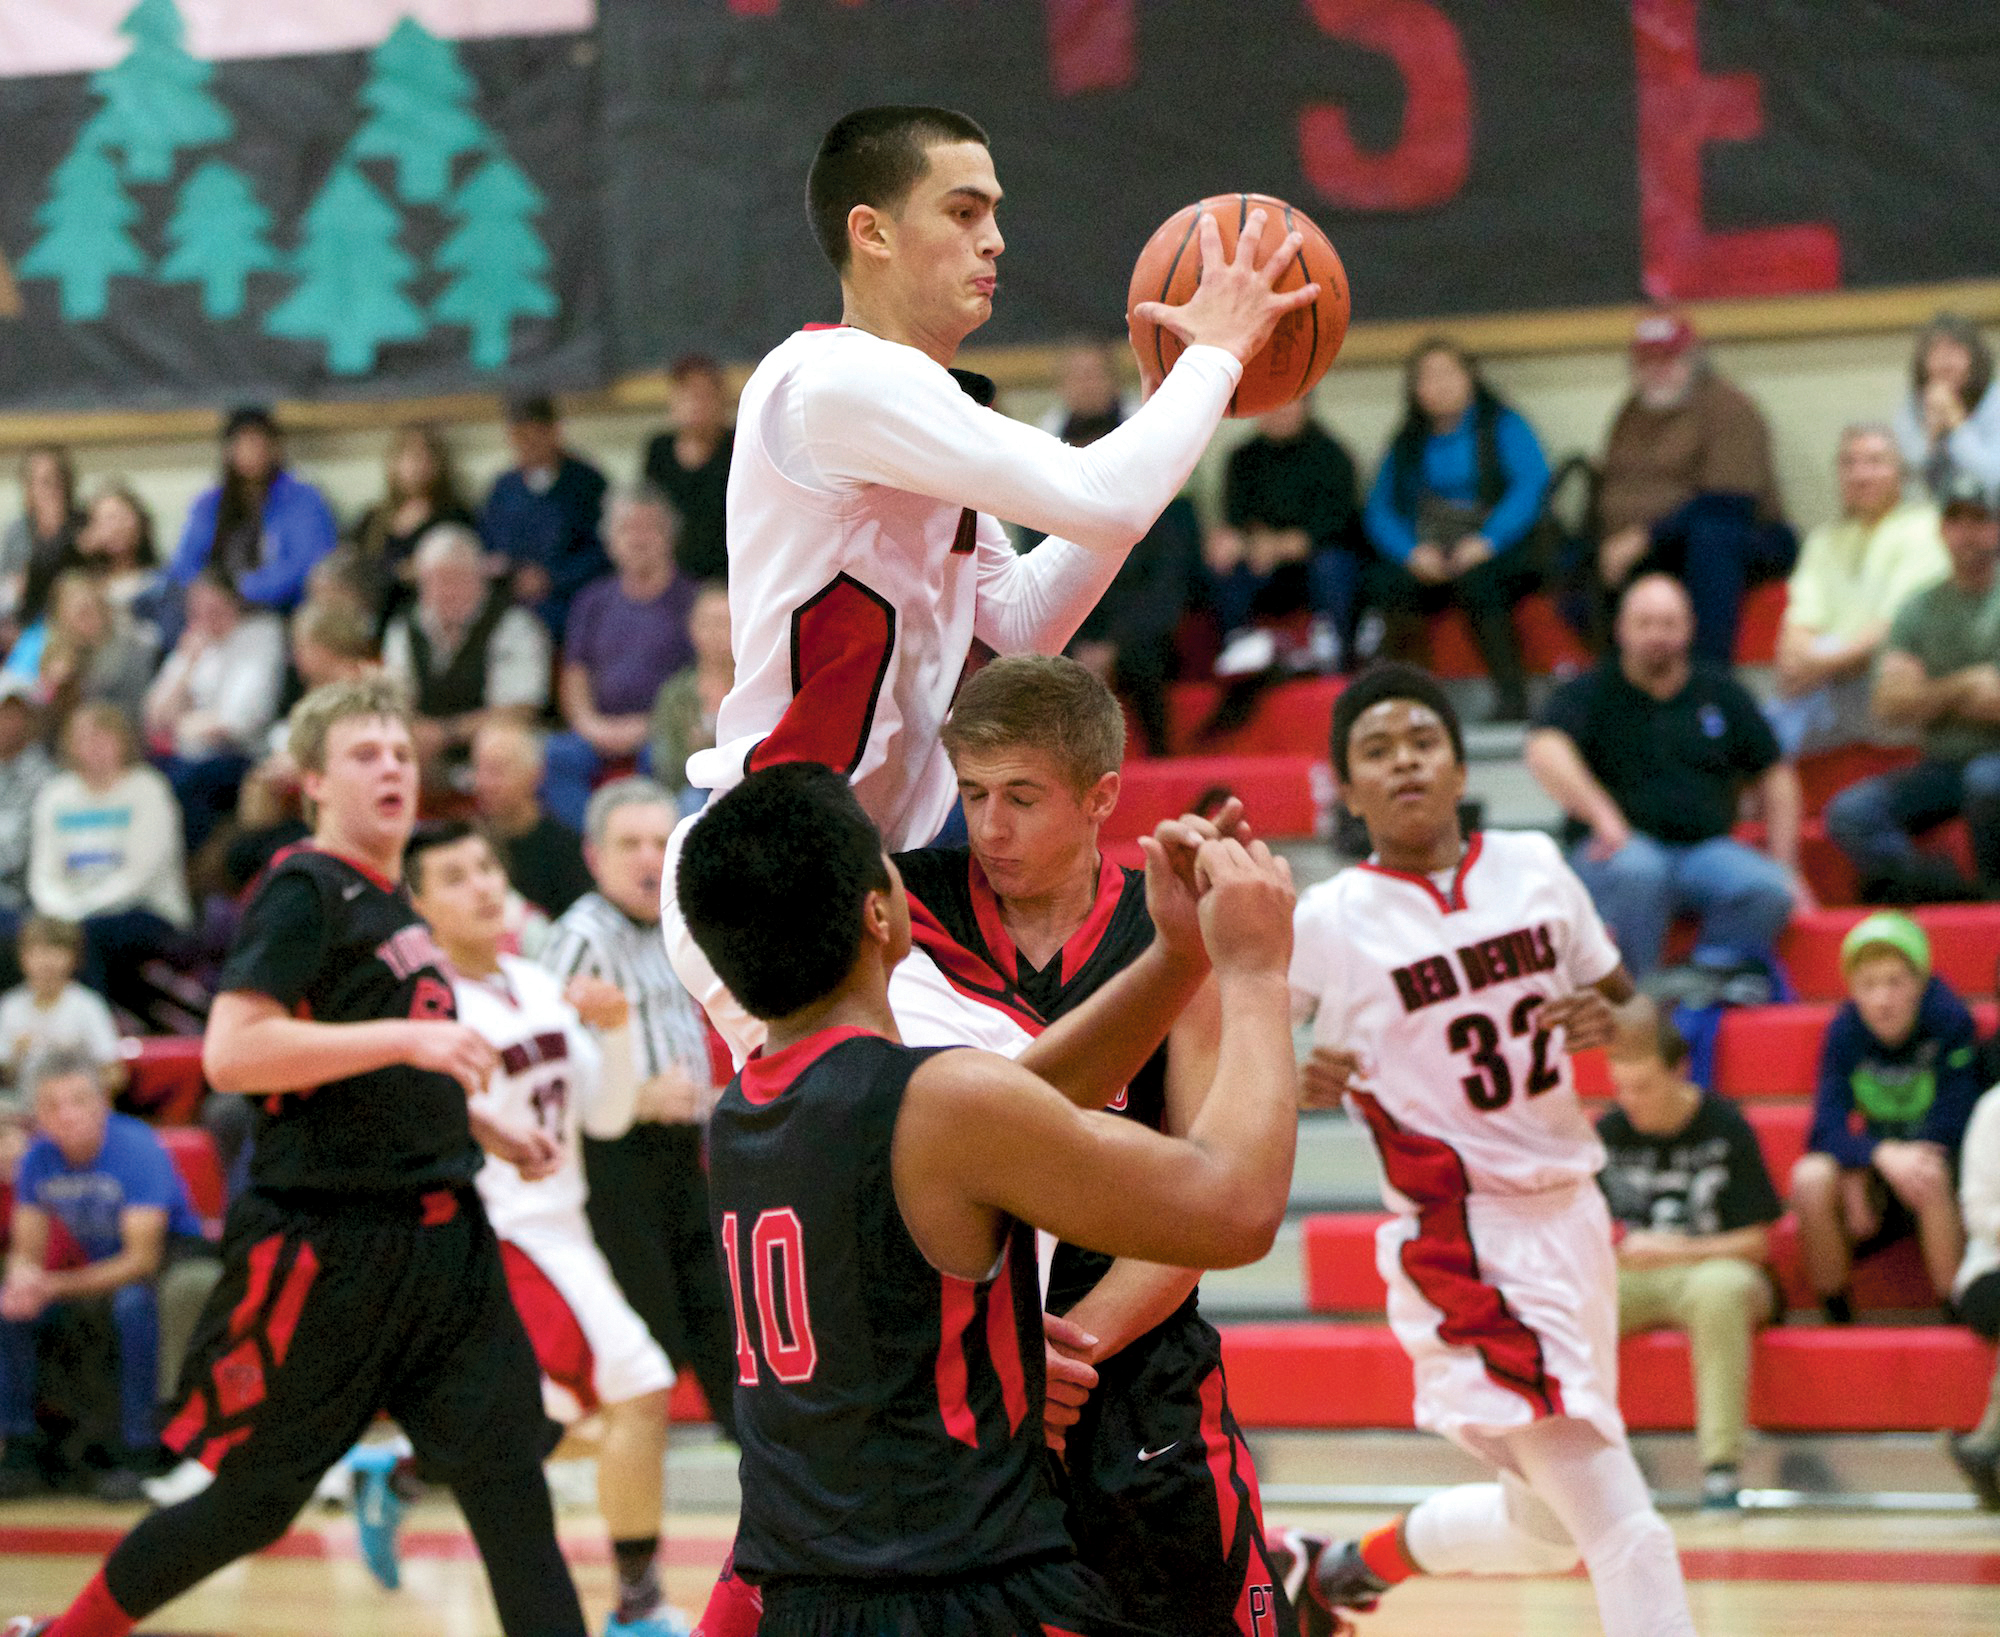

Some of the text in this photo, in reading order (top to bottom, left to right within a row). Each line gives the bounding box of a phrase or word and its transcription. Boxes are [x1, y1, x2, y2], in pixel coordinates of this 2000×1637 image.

[1391, 923, 1557, 1012] RED DEVILS
[1447, 993, 1561, 1113] 32
[721, 1205, 818, 1387] 10
